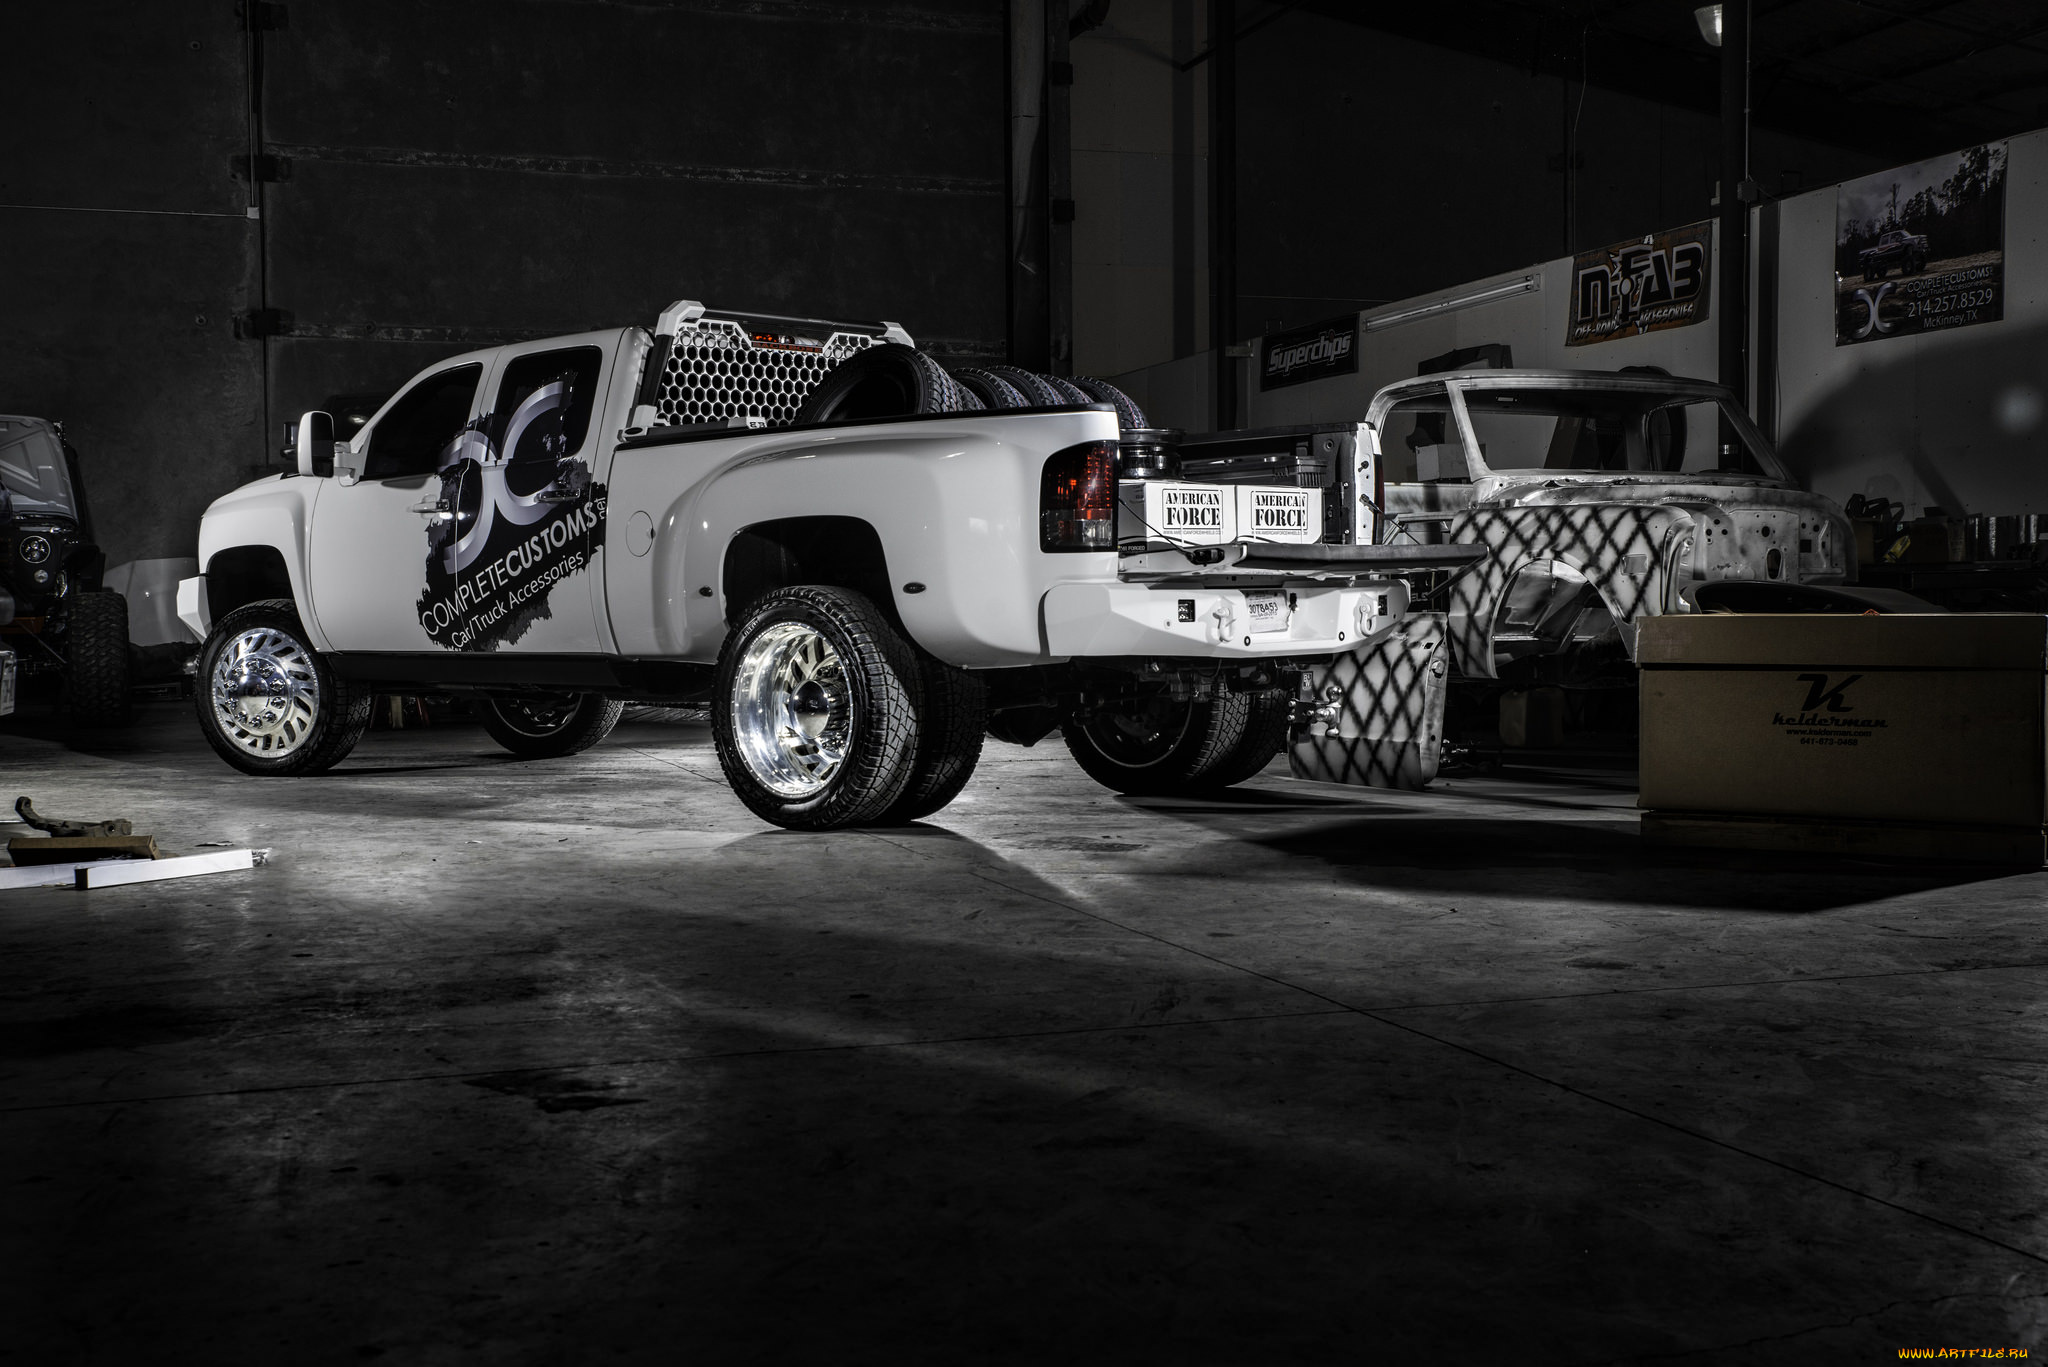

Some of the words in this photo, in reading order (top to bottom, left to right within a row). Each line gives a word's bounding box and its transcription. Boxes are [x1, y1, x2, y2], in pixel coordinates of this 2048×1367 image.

[1908, 288, 1993, 318] 214.257.8529
[1268, 329, 1352, 373] Superchips
[1165, 493, 1220, 505] AMERICAN
[1255, 495, 1306, 507] AMERICAN
[1166, 507, 1220, 526] FORCE
[1255, 508, 1306, 527] FORCE
[422, 502, 597, 635] COMPLETECUSTOMS
[451, 599, 508, 648] Car/Truck
[508, 551, 584, 609] Accessories
